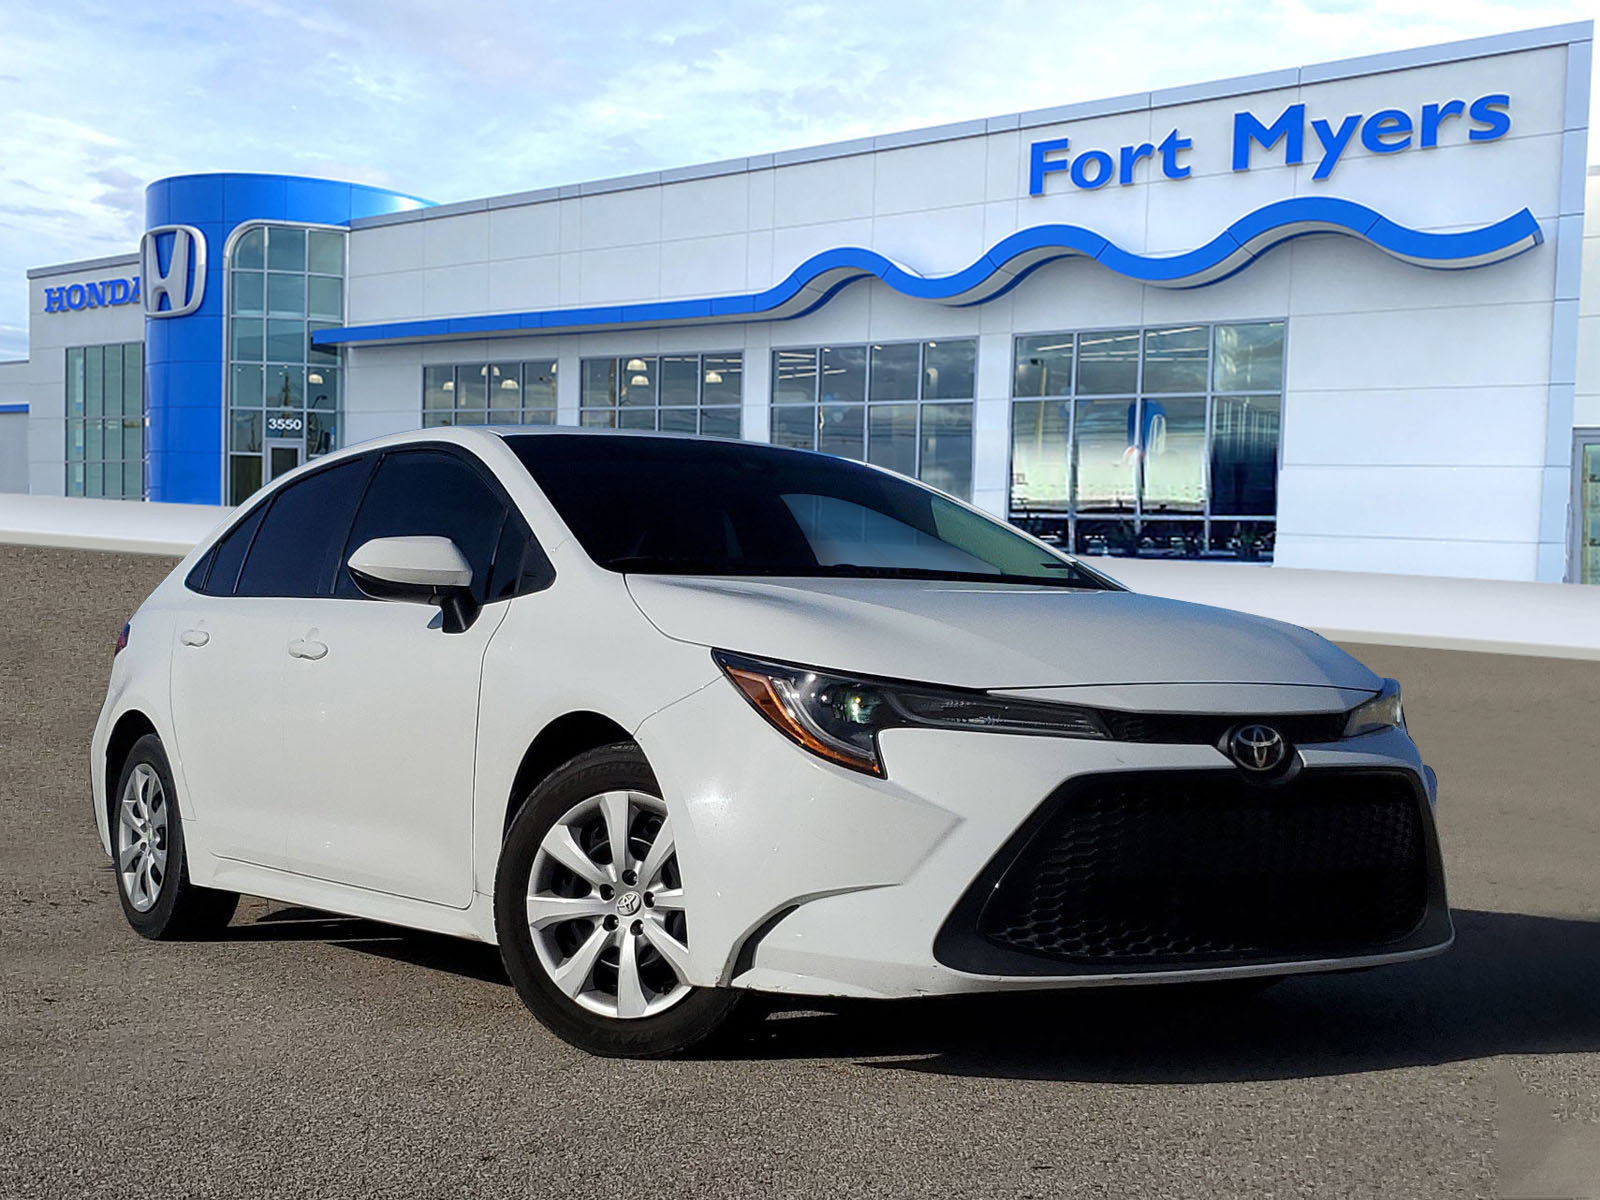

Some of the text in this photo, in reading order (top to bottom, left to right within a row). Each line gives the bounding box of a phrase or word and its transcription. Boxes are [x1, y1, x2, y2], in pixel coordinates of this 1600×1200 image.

[1029, 93, 1512, 196] Fort Myers
[268, 418, 302, 430] 3550
